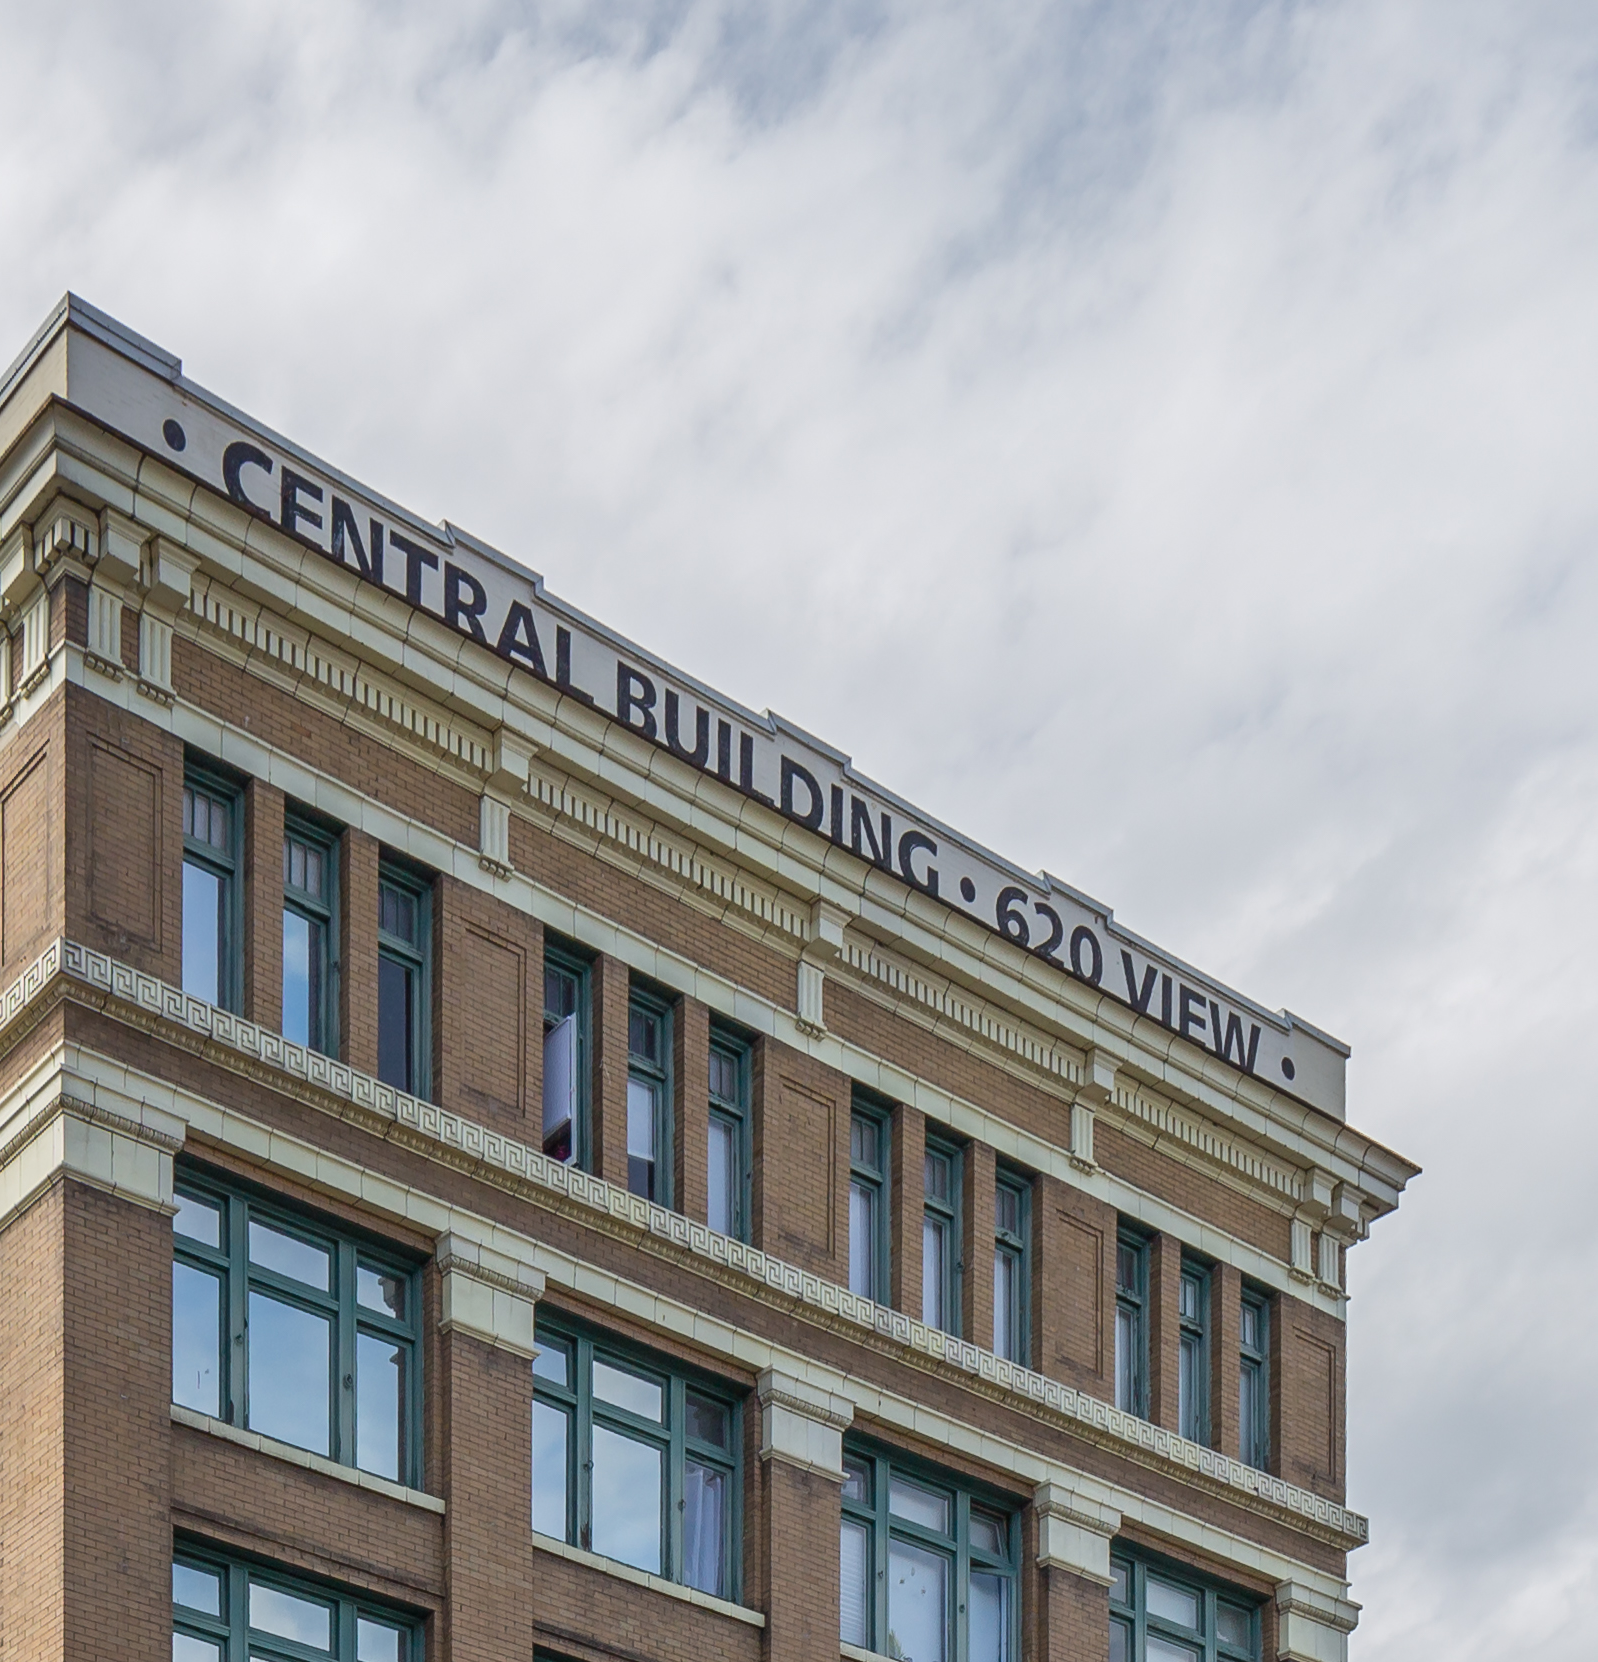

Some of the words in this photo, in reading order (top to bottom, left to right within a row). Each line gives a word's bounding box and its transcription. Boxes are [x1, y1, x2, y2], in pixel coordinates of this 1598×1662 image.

[222, 441, 594, 706] CENTRAL
[617, 660, 940, 897] BUILDING
[995, 886, 1103, 987] 620
[1119, 948, 1262, 1074] VIEW
